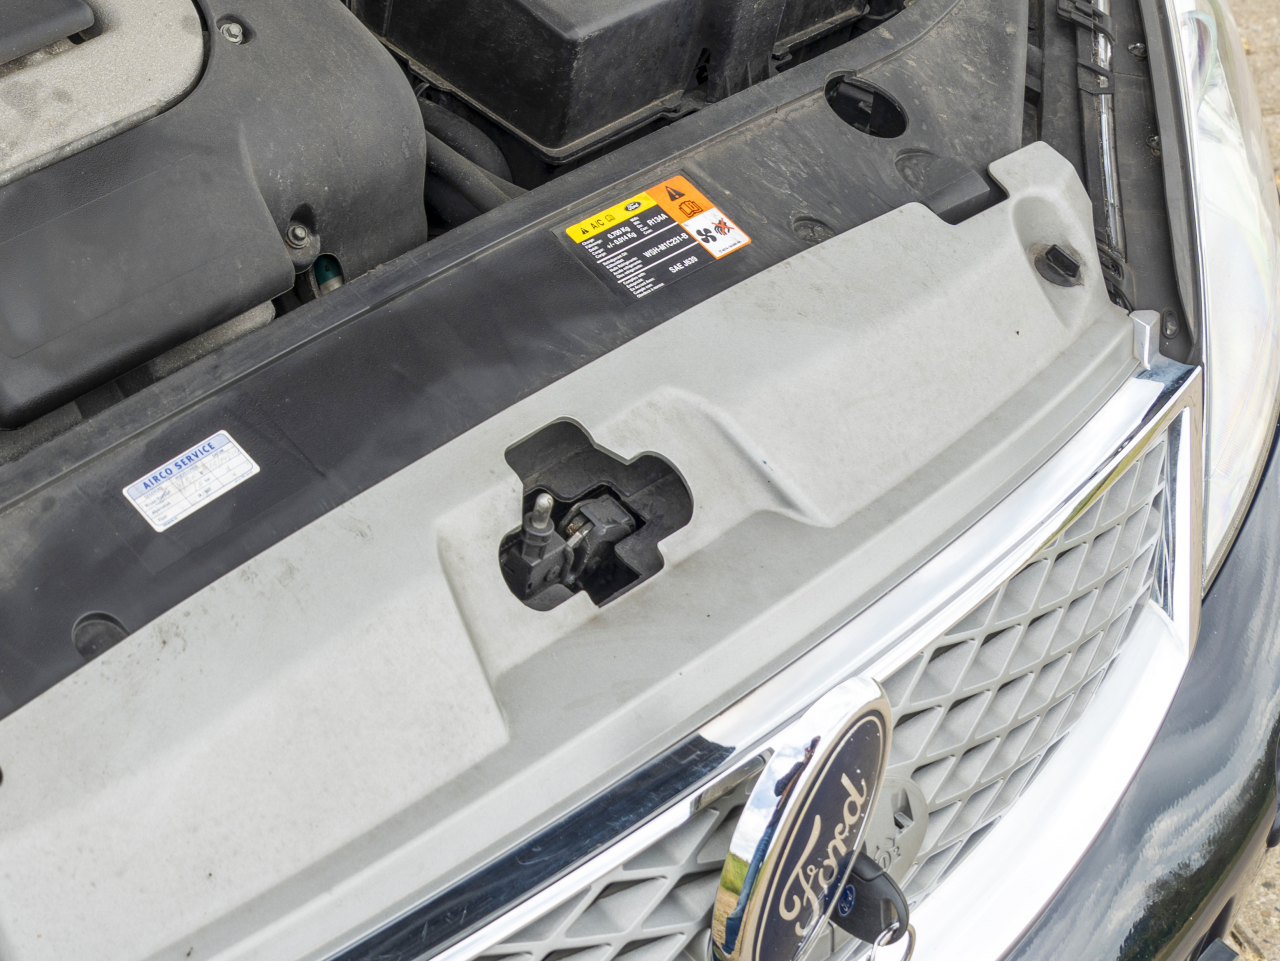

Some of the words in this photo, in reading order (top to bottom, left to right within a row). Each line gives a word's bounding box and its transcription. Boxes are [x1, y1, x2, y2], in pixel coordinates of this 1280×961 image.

[647, 213, 668, 226] R134A
[590, 220, 604, 230] A/C
[621, 225, 631, 235] Kg
[614, 236, 628, 245] 0.014
[668, 263, 685, 273] SAE
[143, 468, 173, 490] AIRCO
[174, 442, 215, 469] SERVICE
[779, 772, 867, 937] Ford
